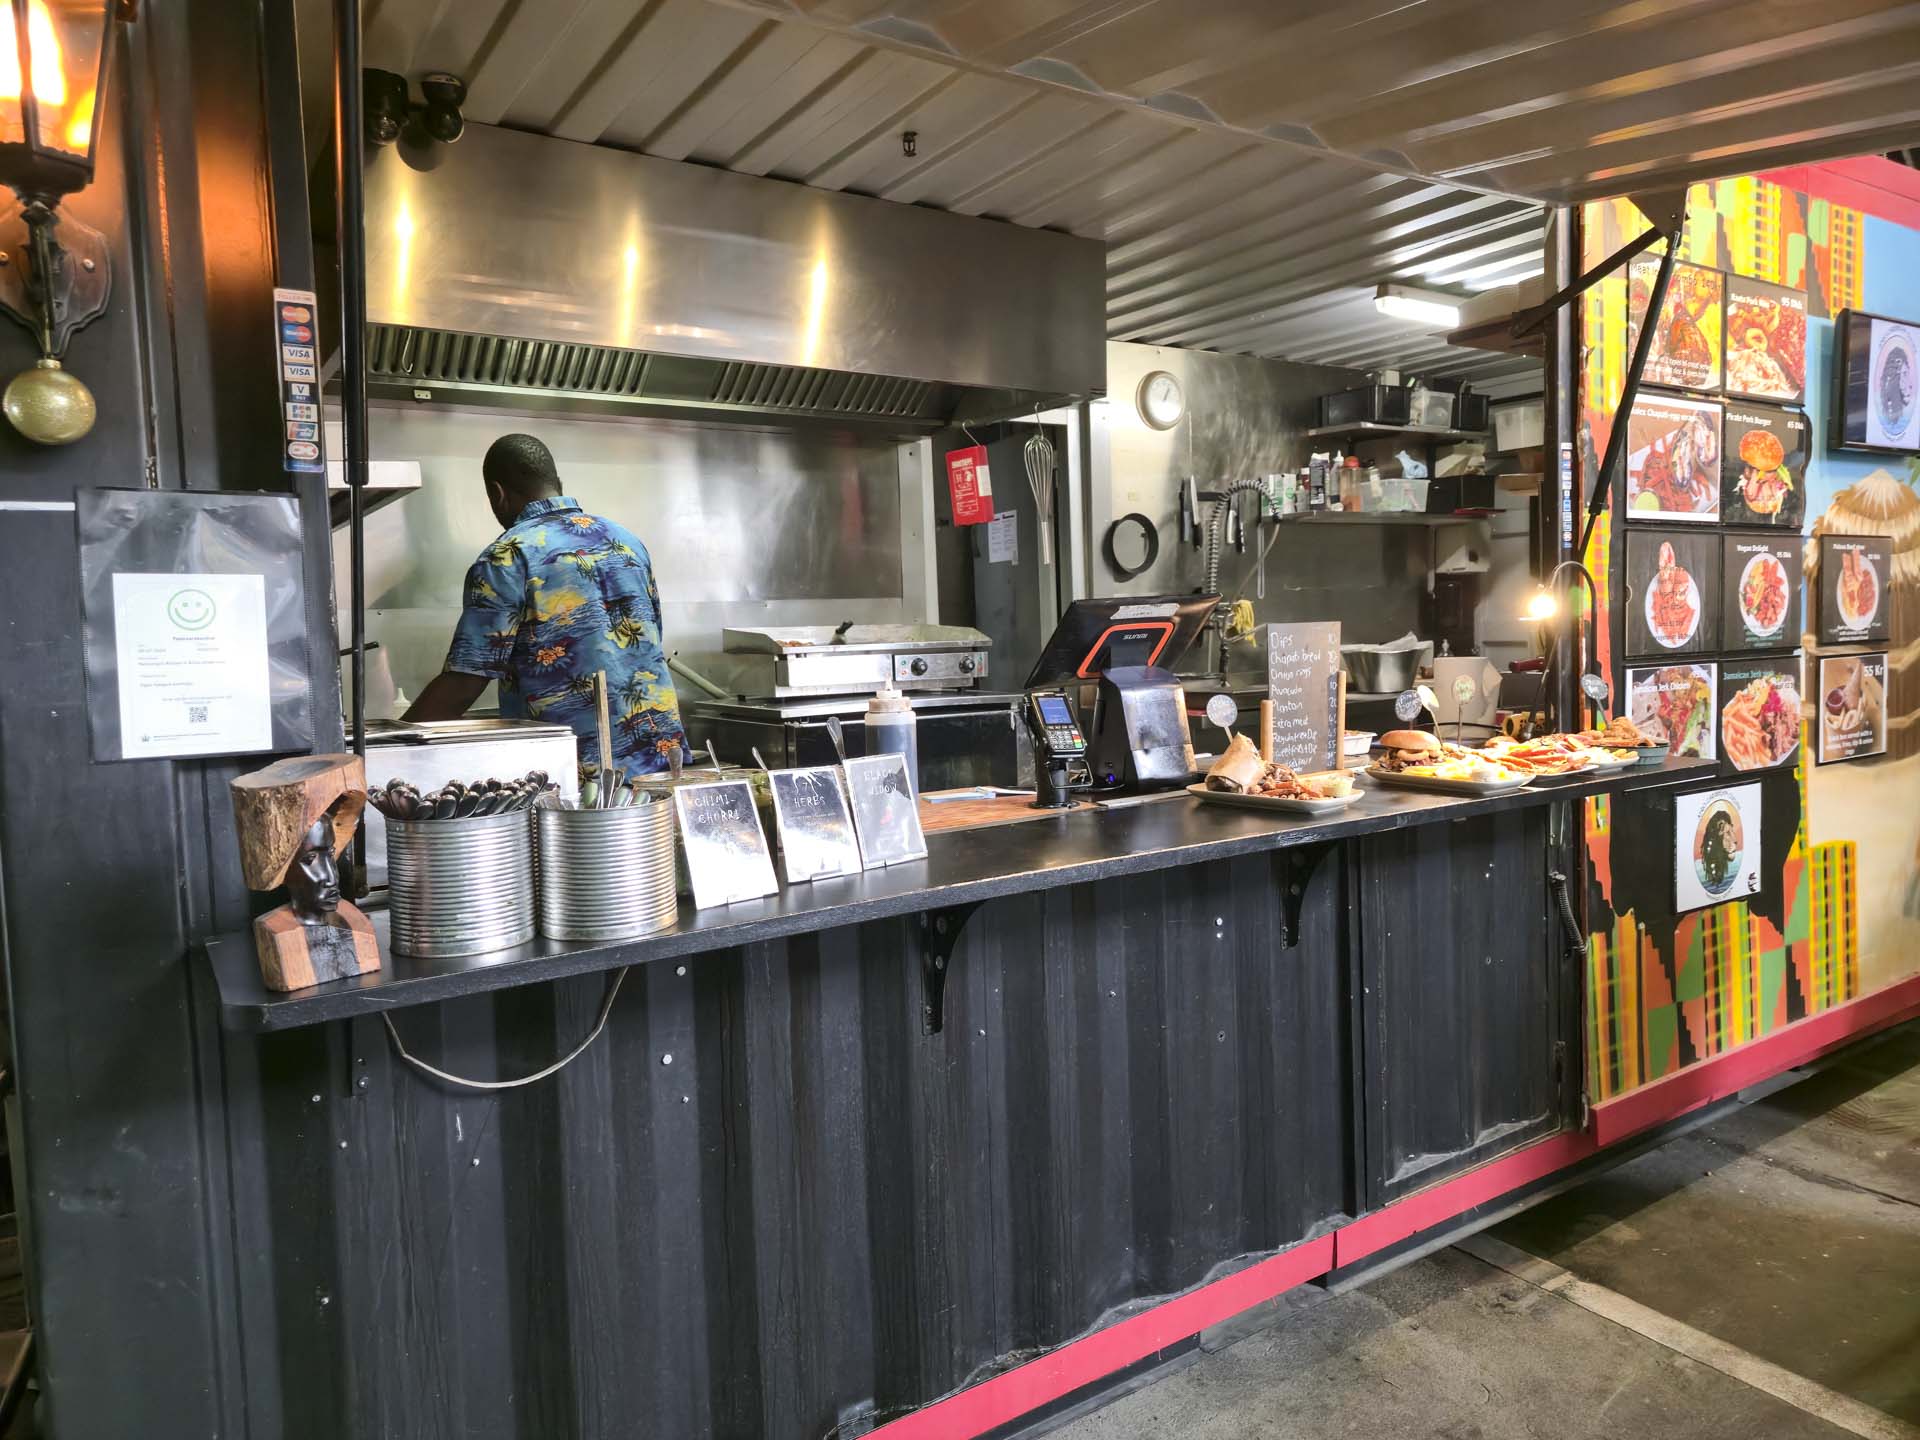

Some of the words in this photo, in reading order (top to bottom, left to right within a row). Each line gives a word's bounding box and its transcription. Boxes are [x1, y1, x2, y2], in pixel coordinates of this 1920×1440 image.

[288, 349, 310, 359] VISA
[288, 367, 310, 376] VISA
[1726, 412, 1741, 421] Pirate
[1742, 415, 1754, 423] Pork
[1754, 416, 1772, 427] Burger
[1737, 544, 1752, 553] Vegan
[1752, 545, 1769, 554] Delight
[1271, 632, 1293, 649] Dips
[1864, 665, 1874, 677] 55
[1875, 665, 1884, 676] Kr
[1658, 683, 1670, 692] Jerk
[1670, 681, 1690, 691] Chicken
[802, 782, 808, 792] 7
[694, 793, 737, 807] CHIMI-
[794, 795, 826, 809] HERBS
[698, 808, 740, 825] CHURRI
